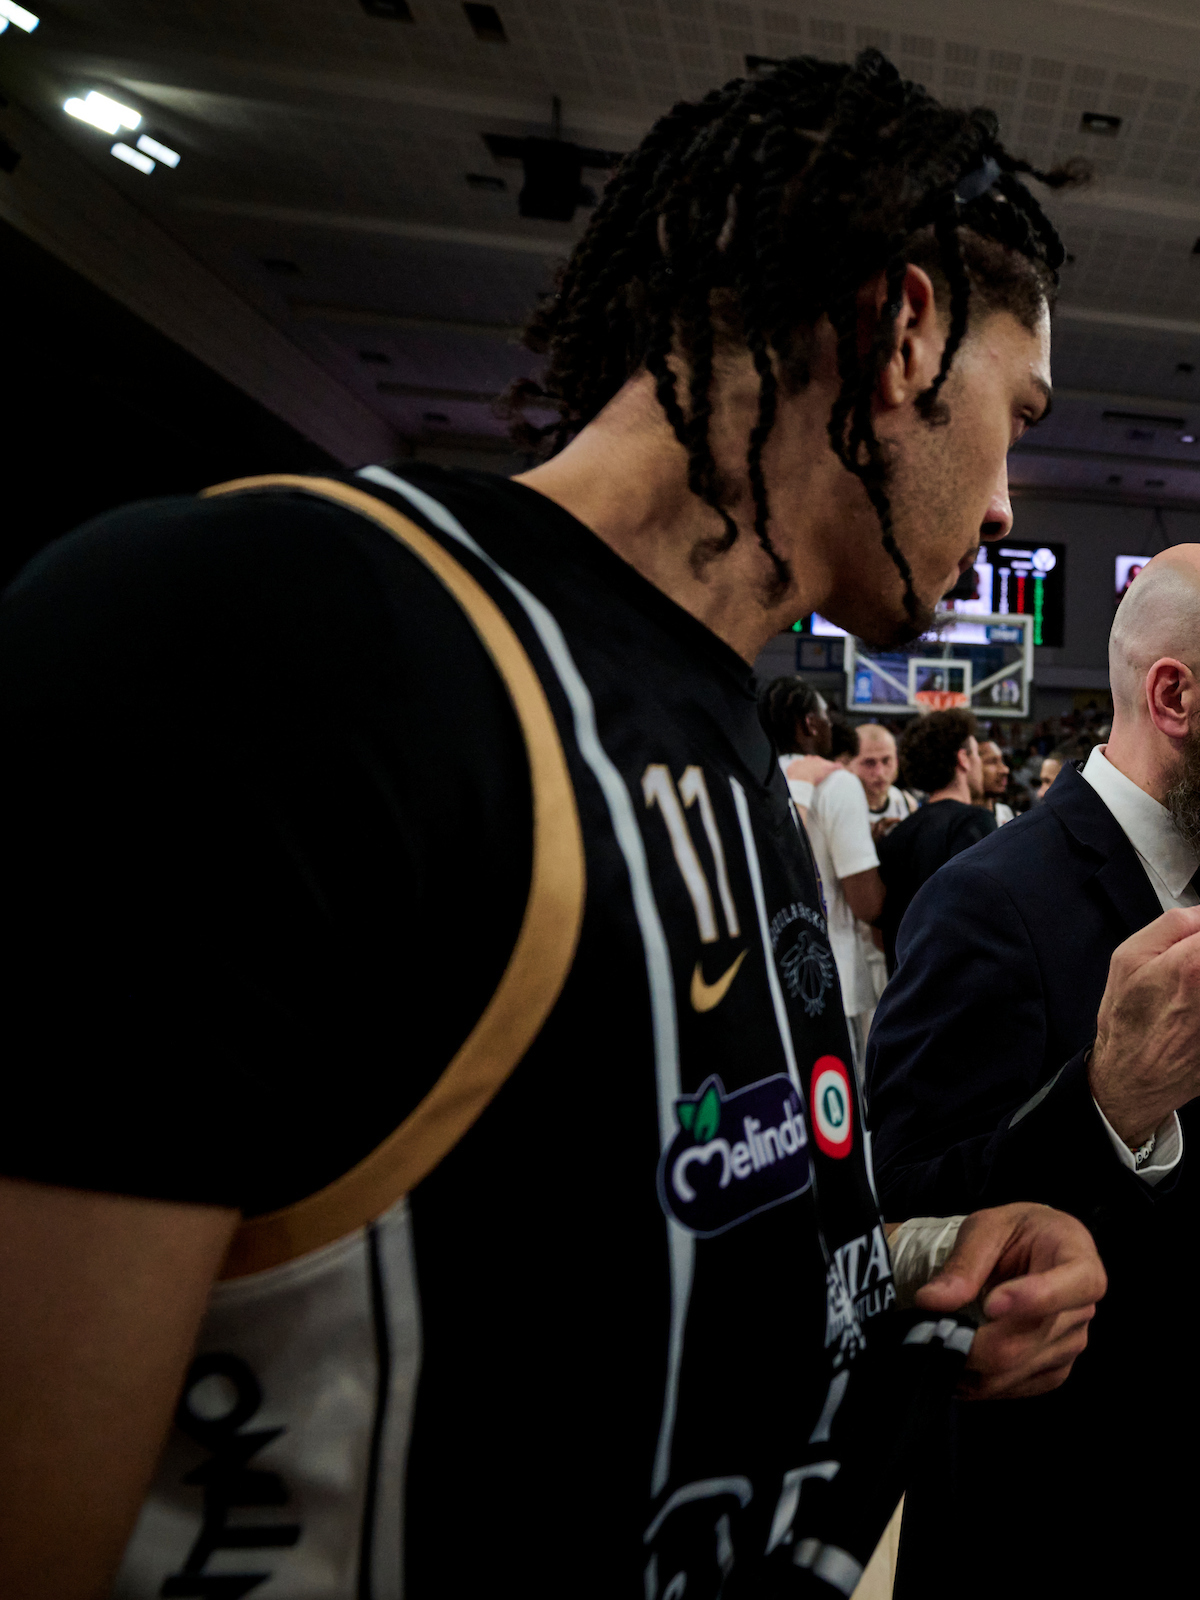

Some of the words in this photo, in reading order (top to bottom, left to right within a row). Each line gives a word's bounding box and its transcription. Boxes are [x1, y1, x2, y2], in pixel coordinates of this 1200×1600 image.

[640, 763, 741, 944] 11
[671, 1098, 808, 1204] Melinda
[833, 1223, 892, 1300] ITA
